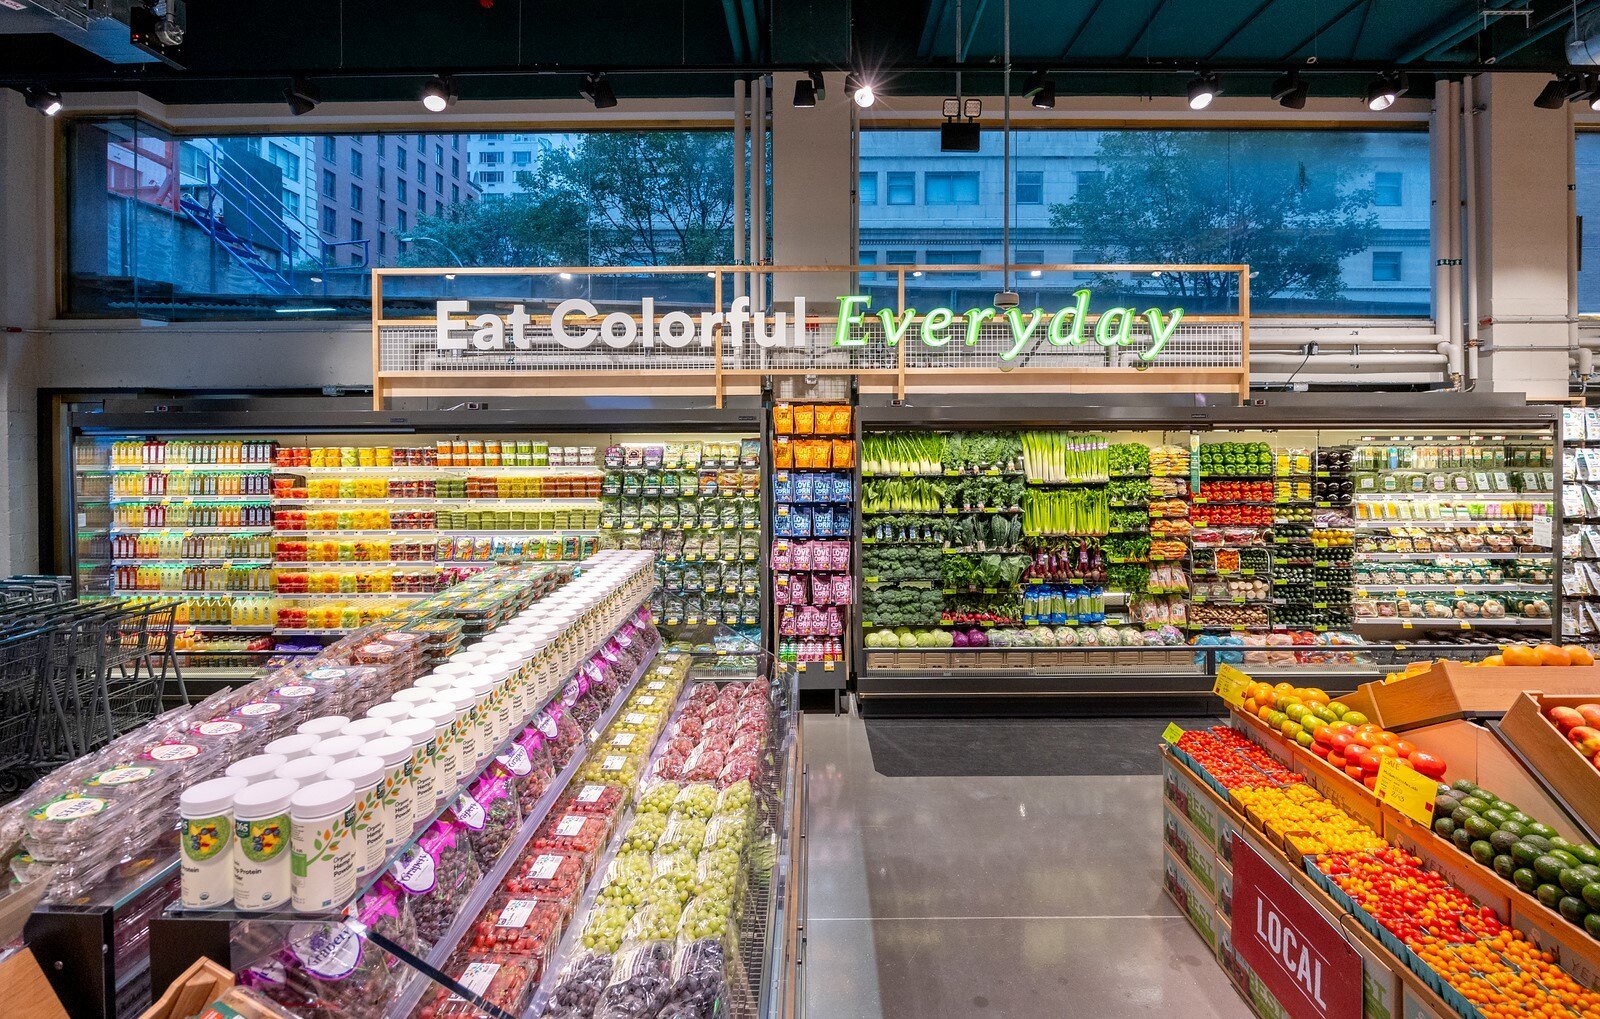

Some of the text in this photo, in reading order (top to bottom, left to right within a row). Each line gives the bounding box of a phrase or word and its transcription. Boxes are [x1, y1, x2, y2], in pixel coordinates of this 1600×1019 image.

[437, 288, 1185, 361] Eat Colorful Everyday
[796, 480, 811, 488] LOVE
[814, 548, 830, 556] LOVE
[459, 802, 479, 821] rapery
[401, 854, 429, 881] Grapery
[1256, 896, 1327, 1011] LOCAL
